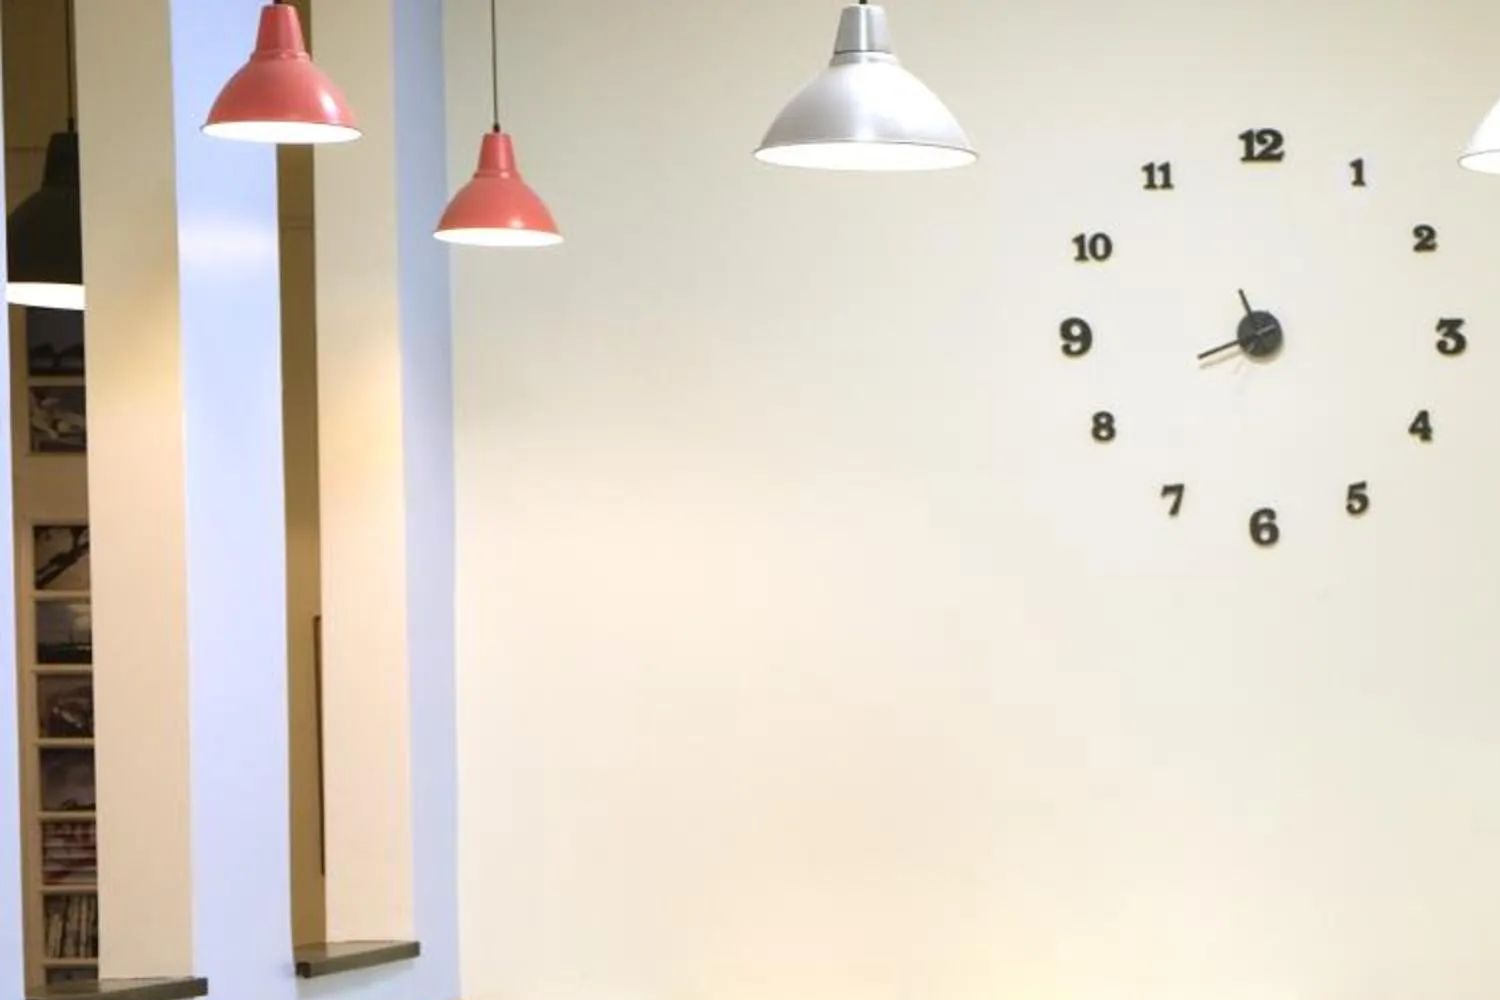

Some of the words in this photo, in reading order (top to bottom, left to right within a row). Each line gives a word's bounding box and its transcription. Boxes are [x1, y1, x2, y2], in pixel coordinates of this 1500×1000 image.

[1238, 128, 1285, 162] 12
[1141, 161, 1174, 190] 11
[1349, 158, 1366, 187] 1
[1072, 232, 1113, 262] 10
[1412, 224, 1438, 253] 2
[1059, 317, 1093, 358] 9
[1435, 317, 1467, 357] 3
[1091, 411, 1116, 442] 8
[1408, 409, 1433, 442] 4
[1161, 483, 1185, 517] 7
[1345, 481, 1370, 516] 5
[1249, 507, 1280, 546] 6
